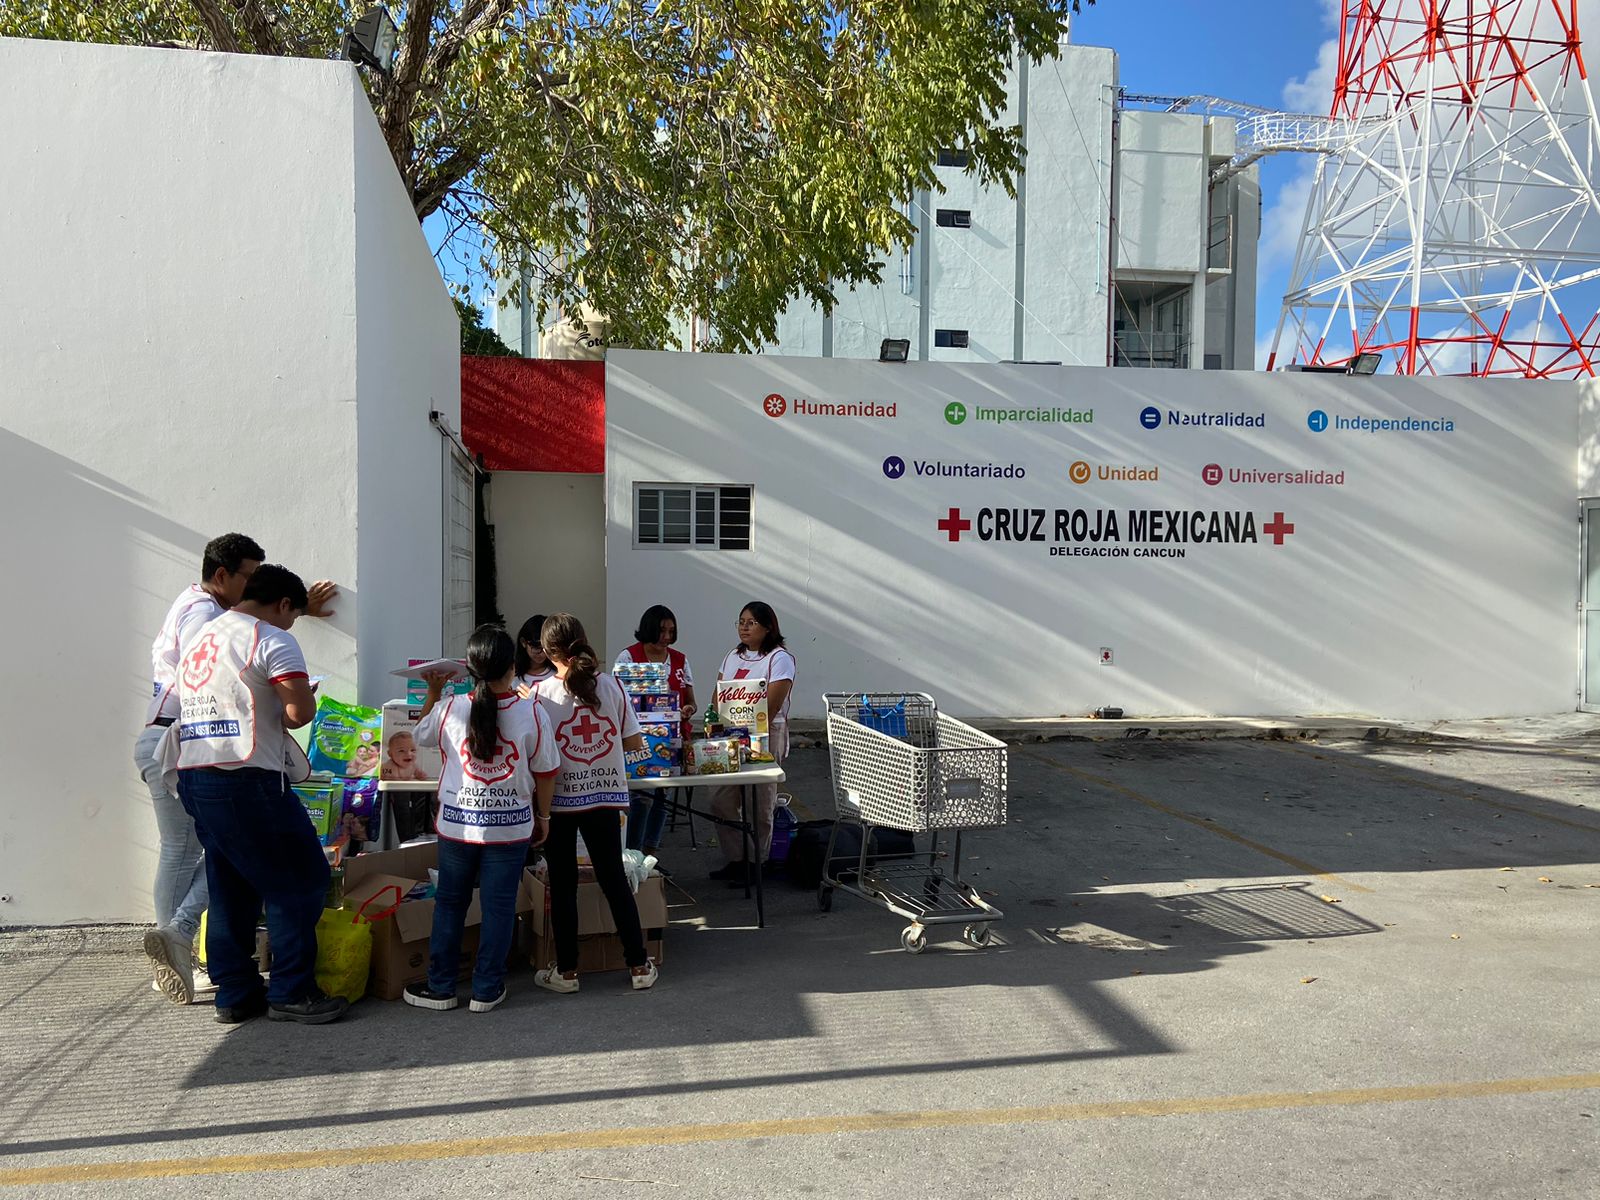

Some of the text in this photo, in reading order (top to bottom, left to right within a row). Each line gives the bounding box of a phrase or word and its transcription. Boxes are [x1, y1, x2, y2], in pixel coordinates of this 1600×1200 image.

[793, 399, 897, 418] Humanidad
[975, 406, 1094, 425] Imparcialidad
[1168, 410, 1265, 428] Neutralidad
[1335, 415, 1454, 434] Independencia
[913, 460, 1026, 479] Voluntariado
[1097, 465, 1159, 481] Unidad
[1228, 467, 1345, 486] Universalidad
[976, 507, 1258, 544] CRUZ ROJA MEXICANA
[1050, 545, 1186, 558] DELEGACIÓN CANCUN
[718, 686, 768, 704] Kellogg's
[729, 706, 754, 715] CORN
[569, 738, 606, 754] JUVENTUD
[469, 762, 507, 774] JUVENTUD
[562, 767, 618, 781] CRUZ ROJA
[489, 788, 518, 797] ROJA
[563, 779, 619, 793] MEXICANA
[457, 797, 519, 808] MEXICANA
[443, 807, 531, 824] SERVICIOS ASISTENCIALES
